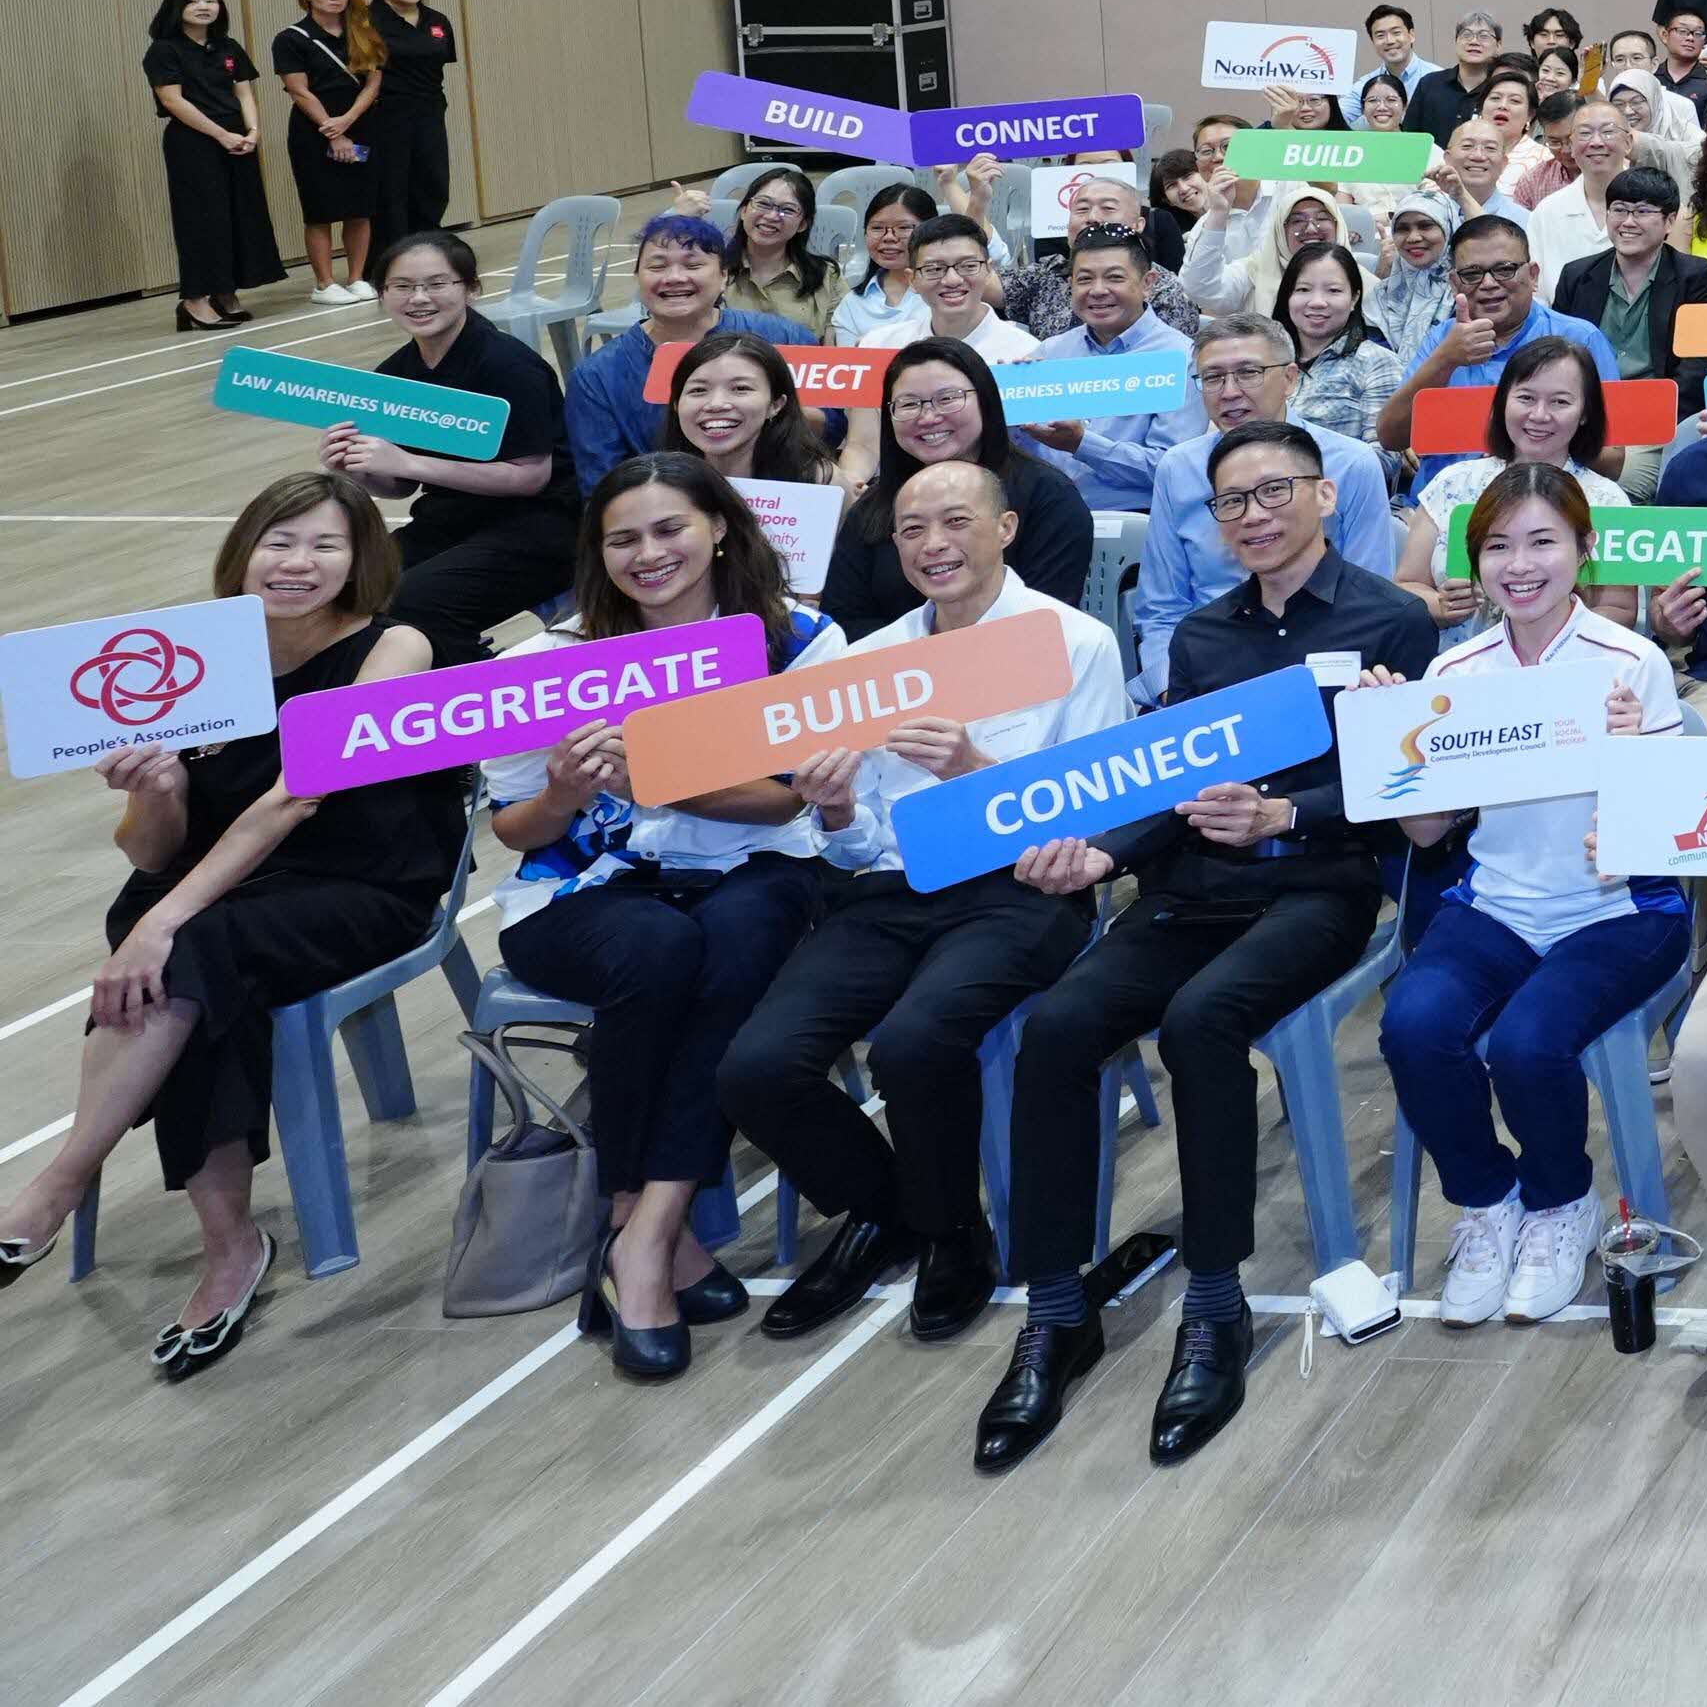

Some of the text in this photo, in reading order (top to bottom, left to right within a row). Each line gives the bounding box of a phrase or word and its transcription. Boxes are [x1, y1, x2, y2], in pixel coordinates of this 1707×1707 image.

[765, 99, 864, 140] BUILD
[955, 113, 1100, 149] CONNECT
[1283, 144, 1364, 167] BUILD
[790, 363, 871, 391] NECT
[1068, 378, 1121, 395] WEEKS
[1125, 376, 1140, 393] @
[1145, 373, 1176, 390] CDC
[231, 371, 491, 435] LAW AWARENESS WEEKS@CDC
[744, 496, 781, 511] ntral
[755, 513, 797, 527] apore
[341, 646, 722, 759] AGGREGATE
[763, 668, 935, 746] BUILD
[133, 718, 235, 745] Association
[1430, 723, 1543, 753] SOUTH EAST
[1430, 741, 1546, 763] Community Development Council
[985, 713, 1244, 835] CONNECT
